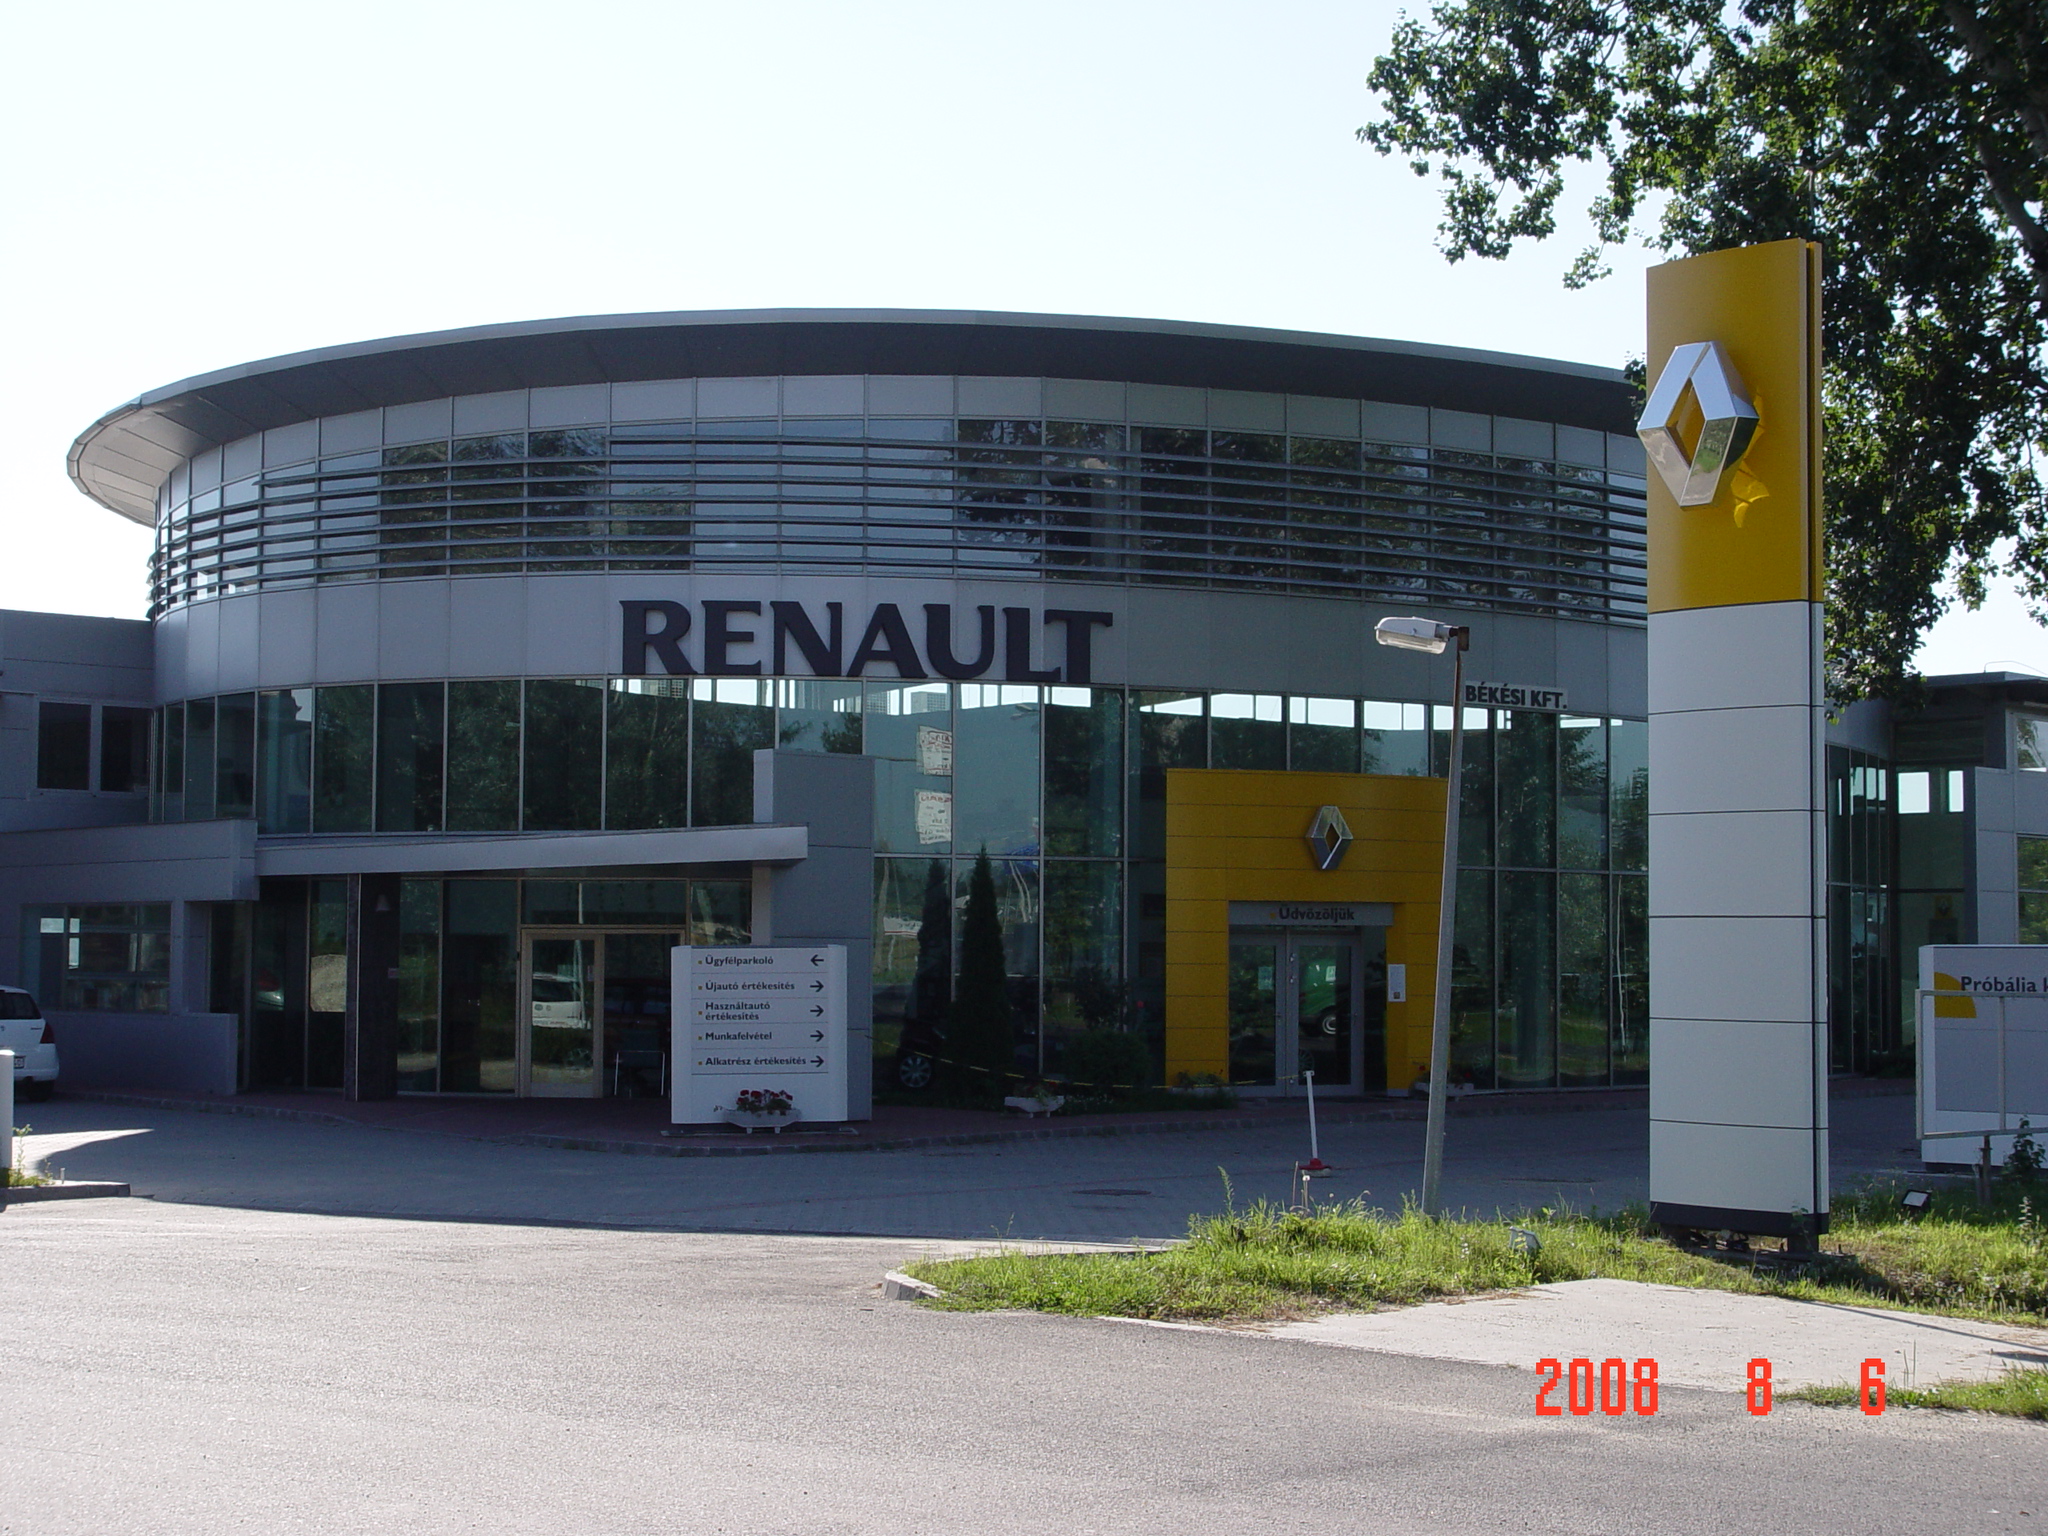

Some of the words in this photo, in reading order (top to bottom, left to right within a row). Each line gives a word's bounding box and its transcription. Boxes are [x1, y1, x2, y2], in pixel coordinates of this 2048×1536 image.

[619, 600, 1113, 683] RENAULT
[1465, 681, 1526, 706] BÉKÉSI
[1530, 689, 1568, 709] KFT.
[1278, 903, 1355, 923] Üdvözöljük
[705, 954, 774, 967] Ügyfélparkoló
[705, 979, 739, 991] Újautó
[741, 981, 795, 991] értékesítés
[705, 1001, 771, 1011] Használtautó
[705, 1012, 760, 1021] értékesítés
[705, 1031, 772, 1041] Munkafelvétel
[705, 1057, 751, 1067] Alkatrész
[753, 1055, 807, 1066] értékesítés
